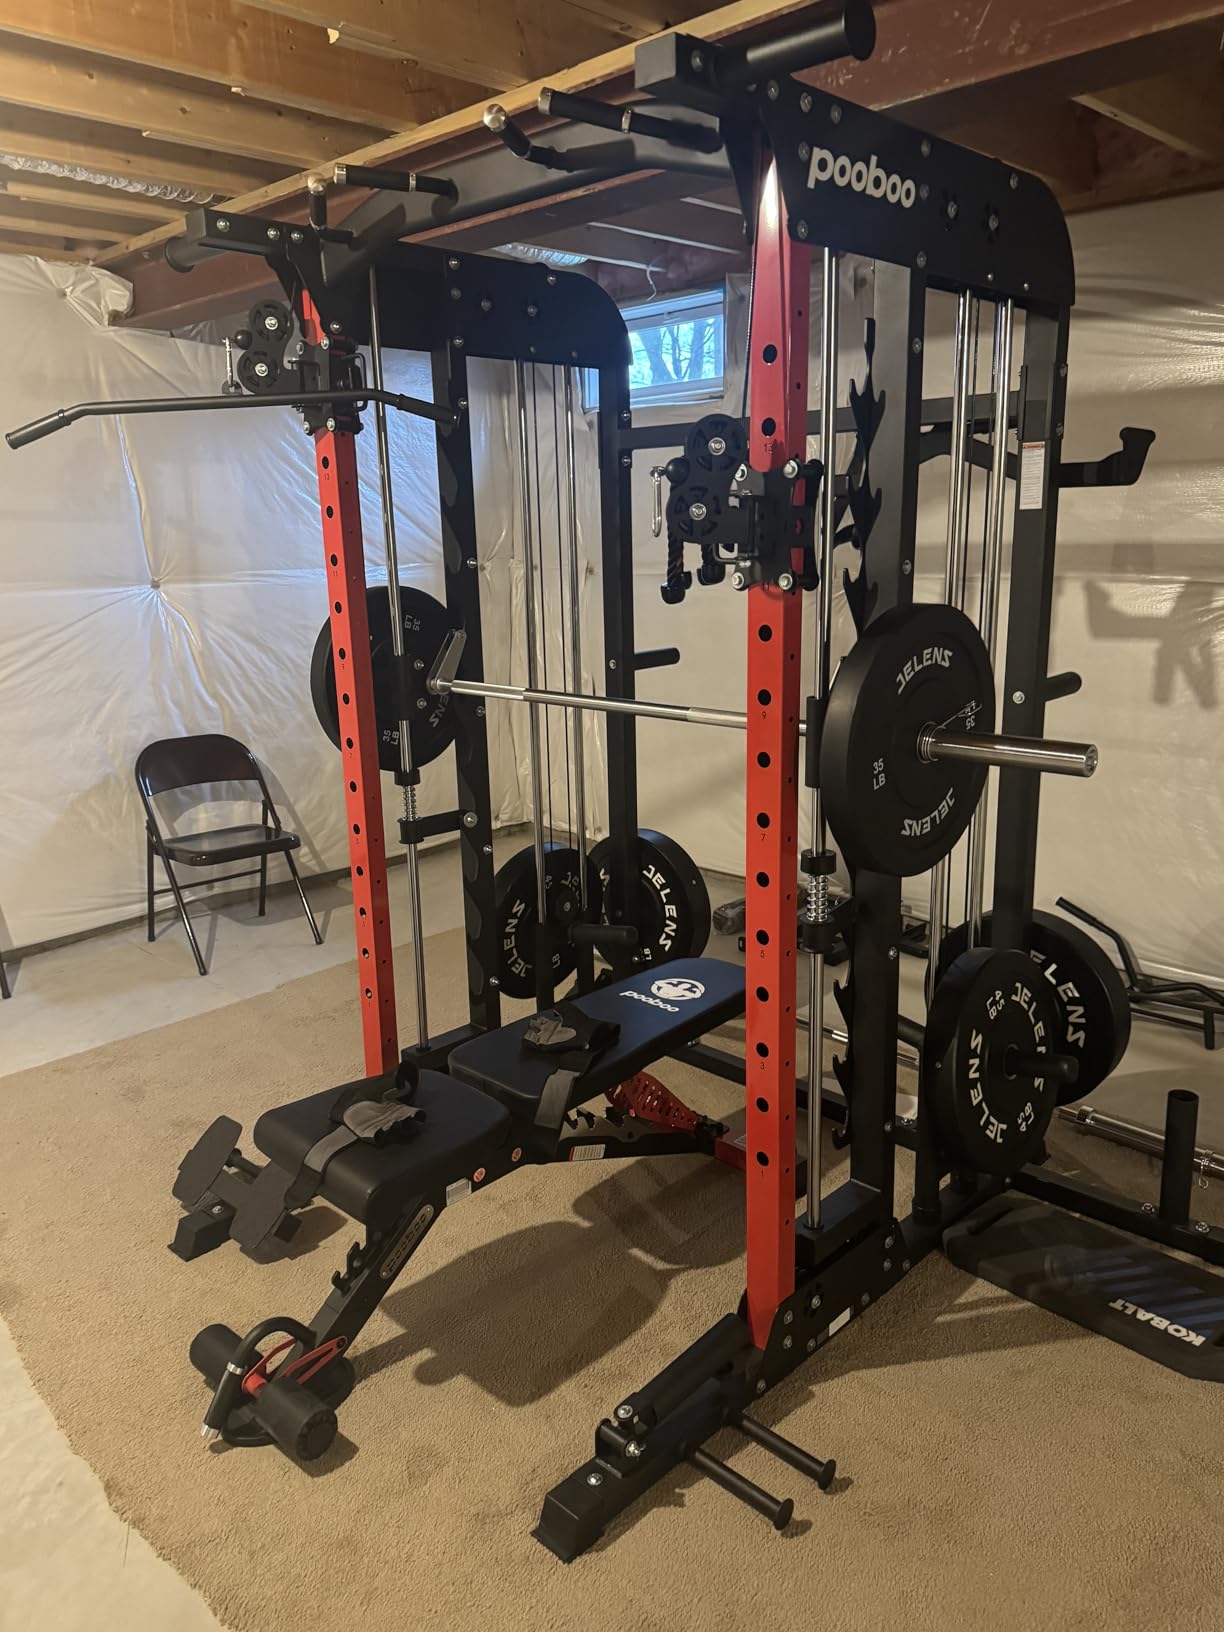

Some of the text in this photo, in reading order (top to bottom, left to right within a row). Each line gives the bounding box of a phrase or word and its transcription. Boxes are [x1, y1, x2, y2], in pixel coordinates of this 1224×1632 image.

[807, 146, 916, 209] pooboo
[896, 646, 953, 695] JELENS
[761, 710, 768, 721] 9
[872, 758, 884, 775] 35
[873, 773, 886, 790] LB
[900, 787, 956, 837] JELENS
[760, 833, 767, 842] 7
[642, 864, 678, 953] JELENS
[503, 898, 533, 977] JELENS
[760, 949, 767, 959] 5
[619, 989, 680, 1013] pooboo
[986, 996, 997, 1020] LB
[994, 989, 1005, 1011] 45
[1030, 949, 1087, 1049] ELENS
[1010, 982, 1048, 1093] JELES
[760, 1061, 766, 1071] 3
[968, 1029, 1008, 1144] JELENS
[1017, 1112, 1028, 1132] 45
[1024, 1102, 1035, 1125] LB
[1107, 1298, 1207, 1347] KOBALT
